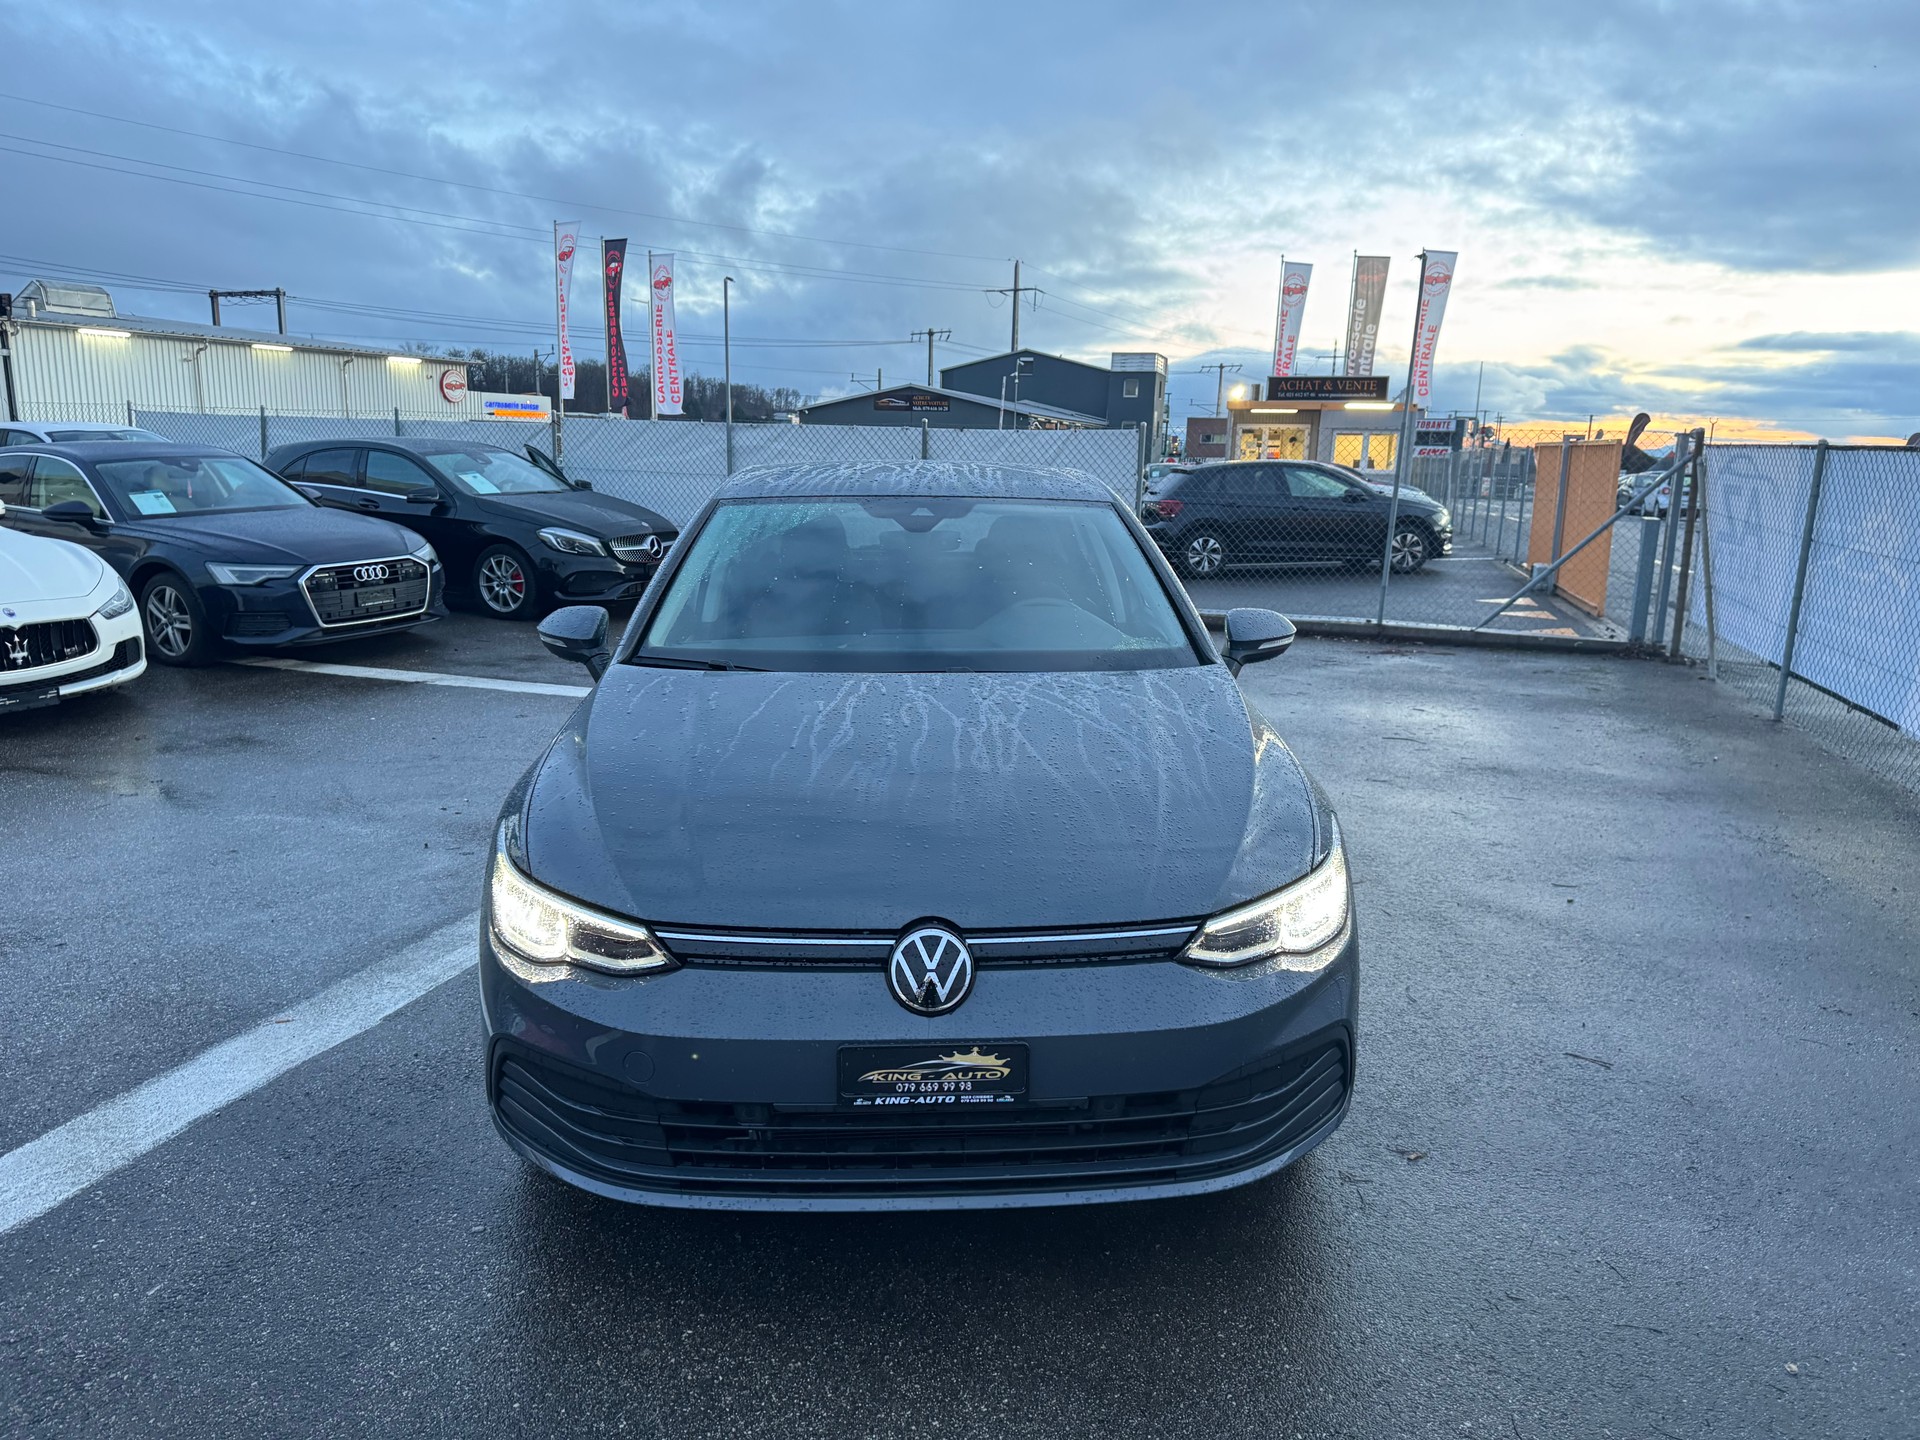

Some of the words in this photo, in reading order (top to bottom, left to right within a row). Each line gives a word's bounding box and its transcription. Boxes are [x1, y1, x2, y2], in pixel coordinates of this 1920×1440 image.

[655, 304, 666, 404] CARROSSERIE
[666, 329, 681, 404] CENTRALE
[1417, 324, 1437, 397] CENTRALE
[1278, 380, 1320, 391] ACHAT
[1323, 380, 1333, 391] &
[1337, 380, 1378, 391] VENTE
[872, 1072, 922, 1082] KING
[941, 1071, 1002, 1081] AUTO
[896, 1083, 916, 1093] 079
[919, 1082, 939, 1092] 669
[942, 1082, 956, 1092] 99
[959, 1081, 972, 1091] 98
[874, 1095, 956, 1105] KING-AUTO
